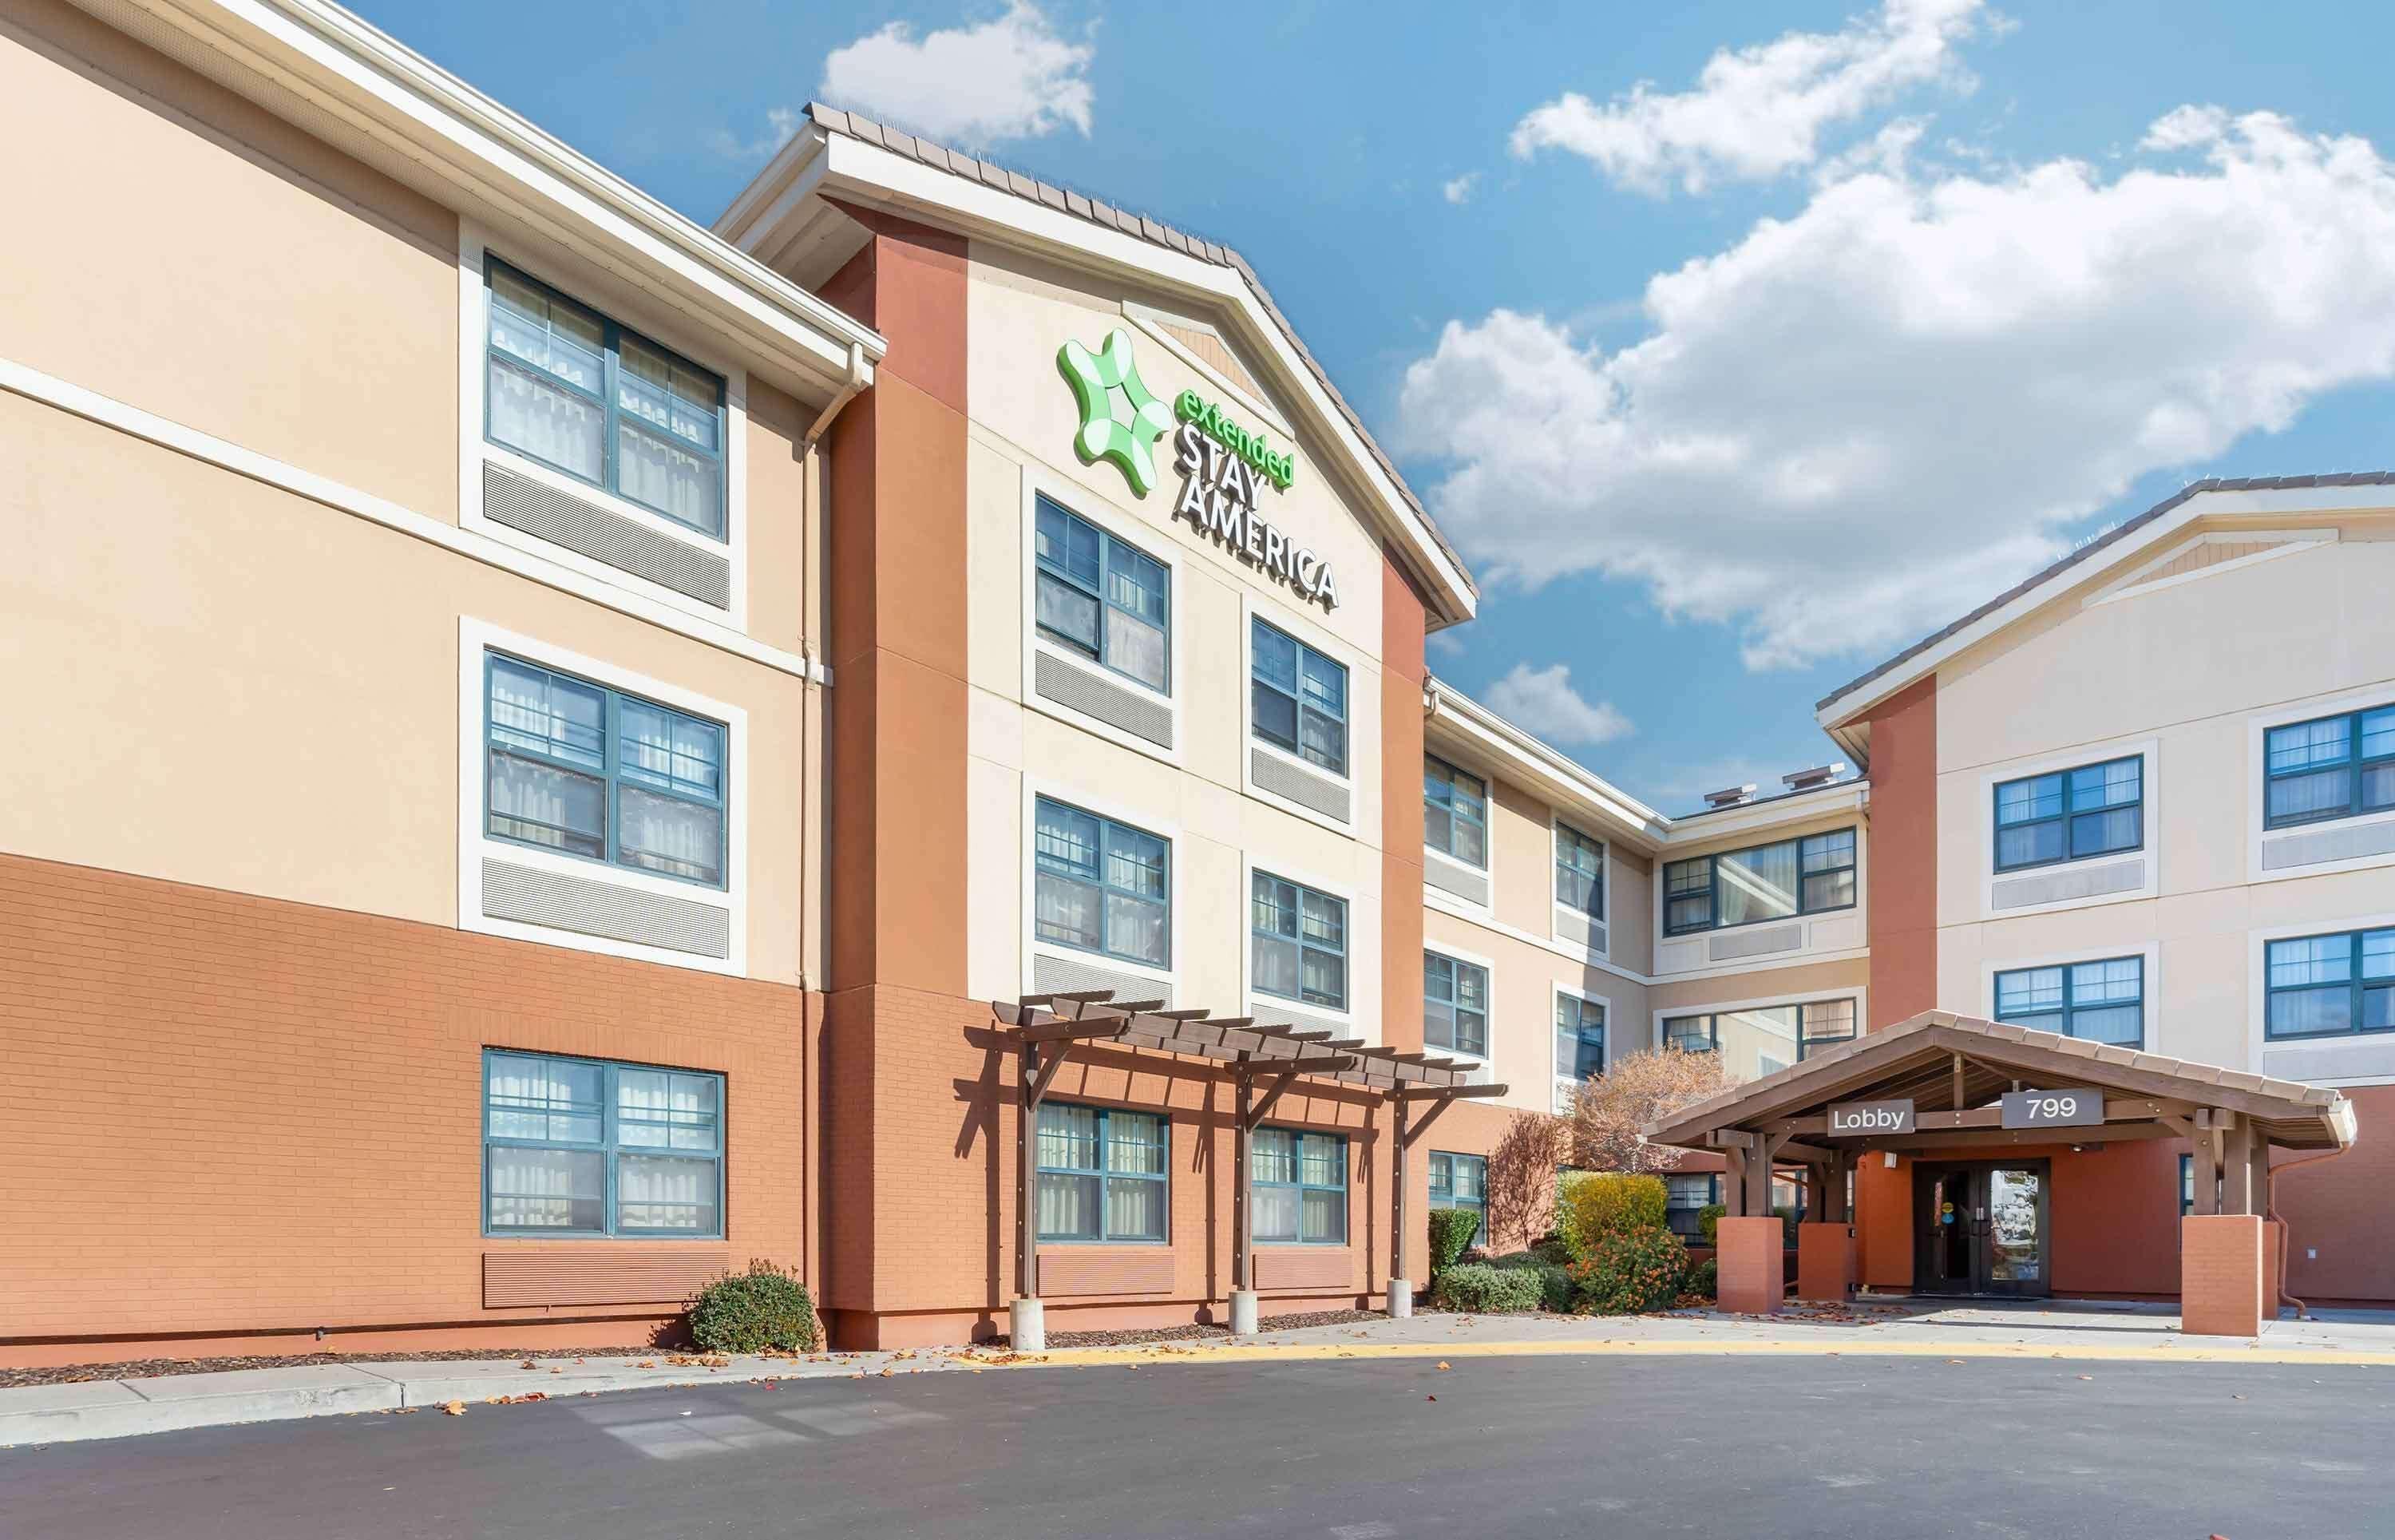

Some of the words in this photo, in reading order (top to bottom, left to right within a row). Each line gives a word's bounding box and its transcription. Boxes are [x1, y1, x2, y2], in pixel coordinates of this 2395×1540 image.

[1181, 422, 1269, 512] STAY
[1182, 390, 1294, 489] extended
[1179, 476, 1340, 609] AMERICA
[1834, 1108, 1906, 1130] Lobby
[2026, 1096, 2077, 1119] 799
